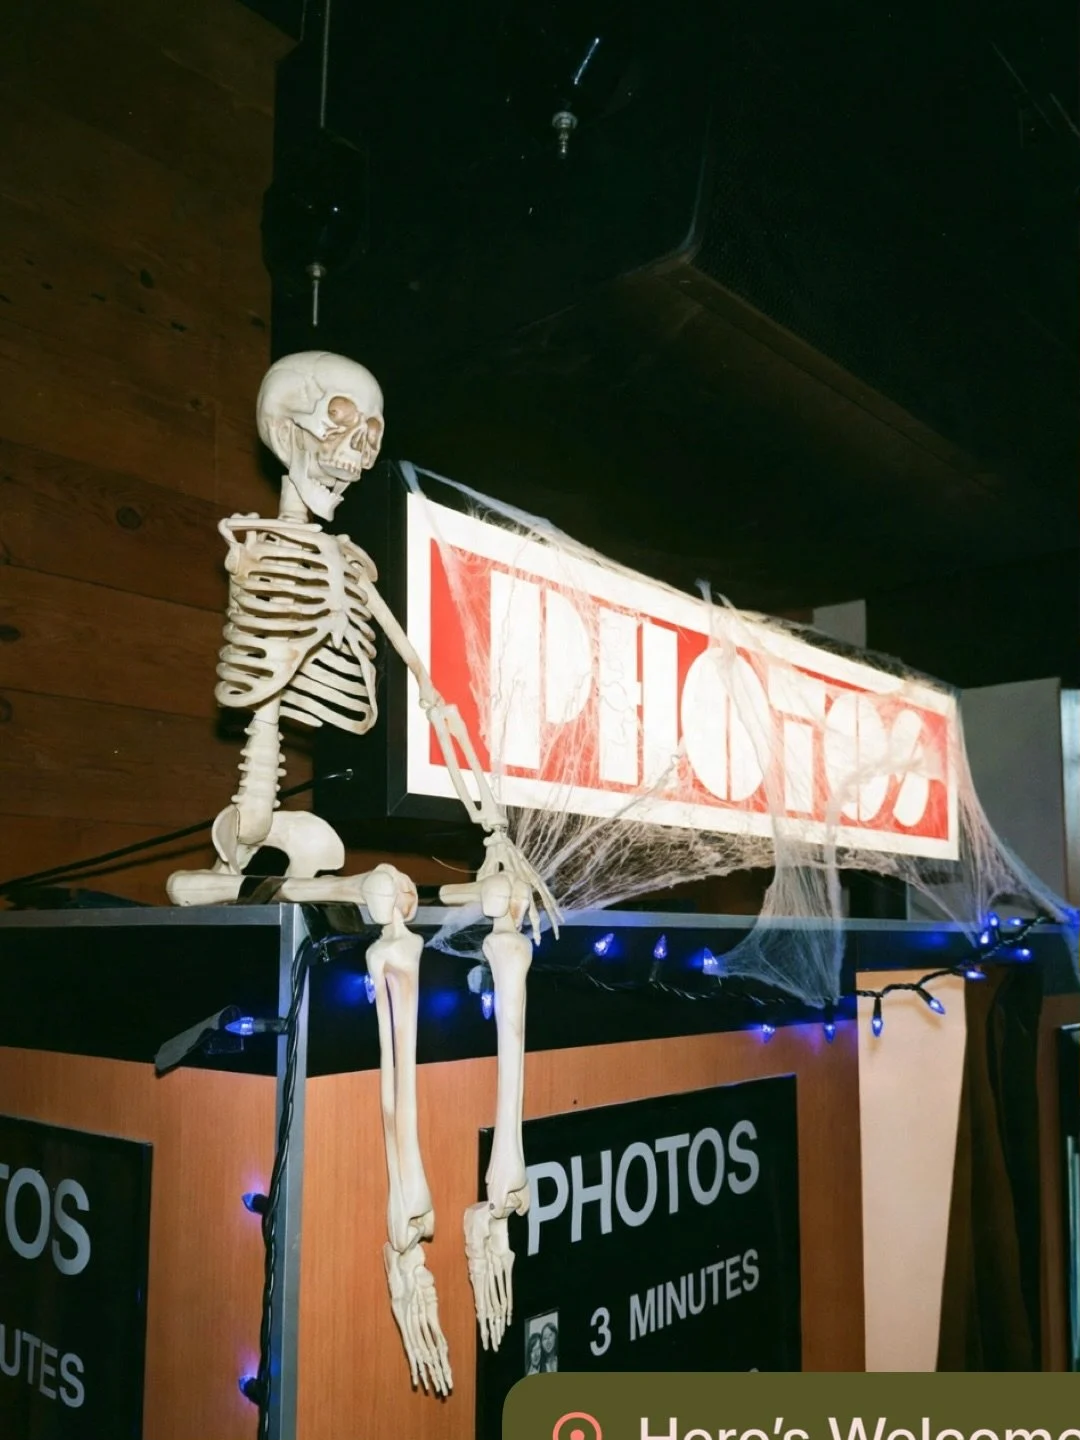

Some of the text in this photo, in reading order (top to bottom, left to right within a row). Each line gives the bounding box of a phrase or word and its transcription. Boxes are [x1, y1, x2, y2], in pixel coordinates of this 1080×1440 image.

[489, 570, 929, 828] PHOTOS
[0, 1163, 91, 1276] OS
[526, 1119, 760, 1257] PHOTOS
[590, 1249, 760, 1356] 3 MINUTES
